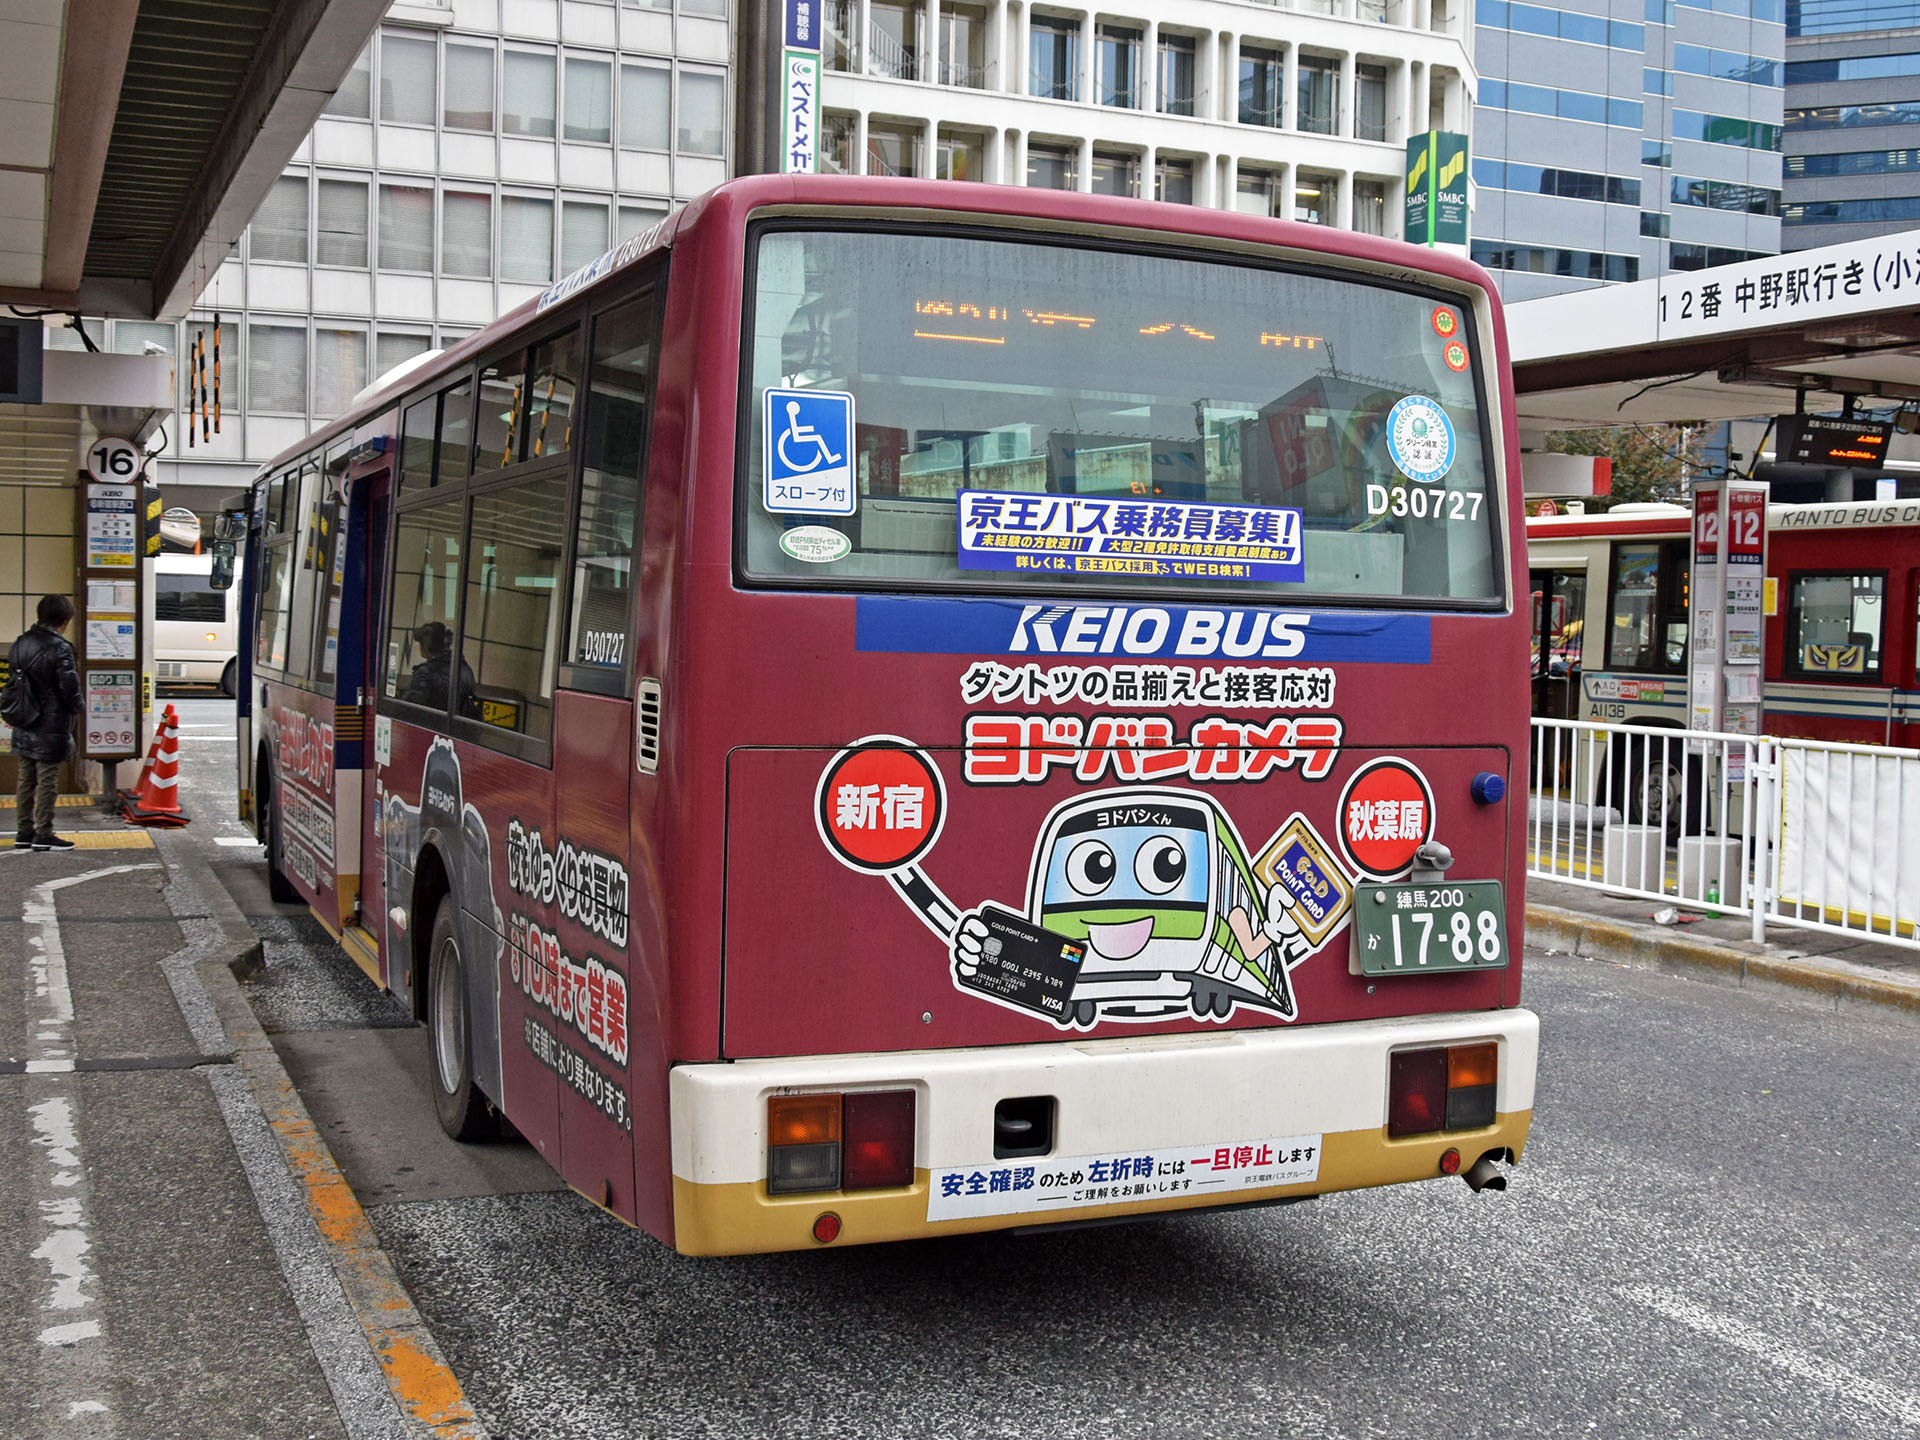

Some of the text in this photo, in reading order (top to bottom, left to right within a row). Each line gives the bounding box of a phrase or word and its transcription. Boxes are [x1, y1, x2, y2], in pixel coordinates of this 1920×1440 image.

[791, 80, 812, 174] ベストメガ
[1407, 192, 1428, 207] SMBC
[1438, 191, 1465, 205] SMBC
[1735, 248, 1920, 314] 中野駅行き(小
[93, 447, 134, 476] 16
[775, 485, 846, 502] スロープ付
[1366, 484, 1484, 521] D30727
[966, 496, 1296, 545] 京王バス乗務員募集!
[1697, 511, 1719, 543] 12
[1732, 511, 1760, 545] 12
[1781, 506, 1920, 526] KANTO BUS C
[981, 533, 1085, 551] 未経験の方歓迎!!
[585, 630, 625, 663] D30727
[1008, 605, 1311, 658] KEIO BUS
[963, 665, 1334, 704] ダントツの品揃えと接客応対
[1590, 703, 1625, 718] A1138
[967, 719, 1340, 779] ヨドバシカメラ
[836, 784, 924, 830] 新宿
[1096, 808, 1172, 827] ヨドバシくん
[1349, 800, 1424, 841] 秋葉原
[1296, 856, 1329, 899] GOLD
[1300, 890, 1324, 920] CARD
[1366, 933, 1382, 950] か
[1391, 910, 1501, 967] 17-88
[1001, 960, 1020, 973] 0001
[1023, 967, 1042, 981] 2345
[1045, 975, 1064, 989] 6789
[1041, 993, 1064, 1012] VISA
[1071, 1179, 1193, 1202] ご理解をお願いします
[1243, 1168, 1314, 1184] 京王電鉄バスグループ
